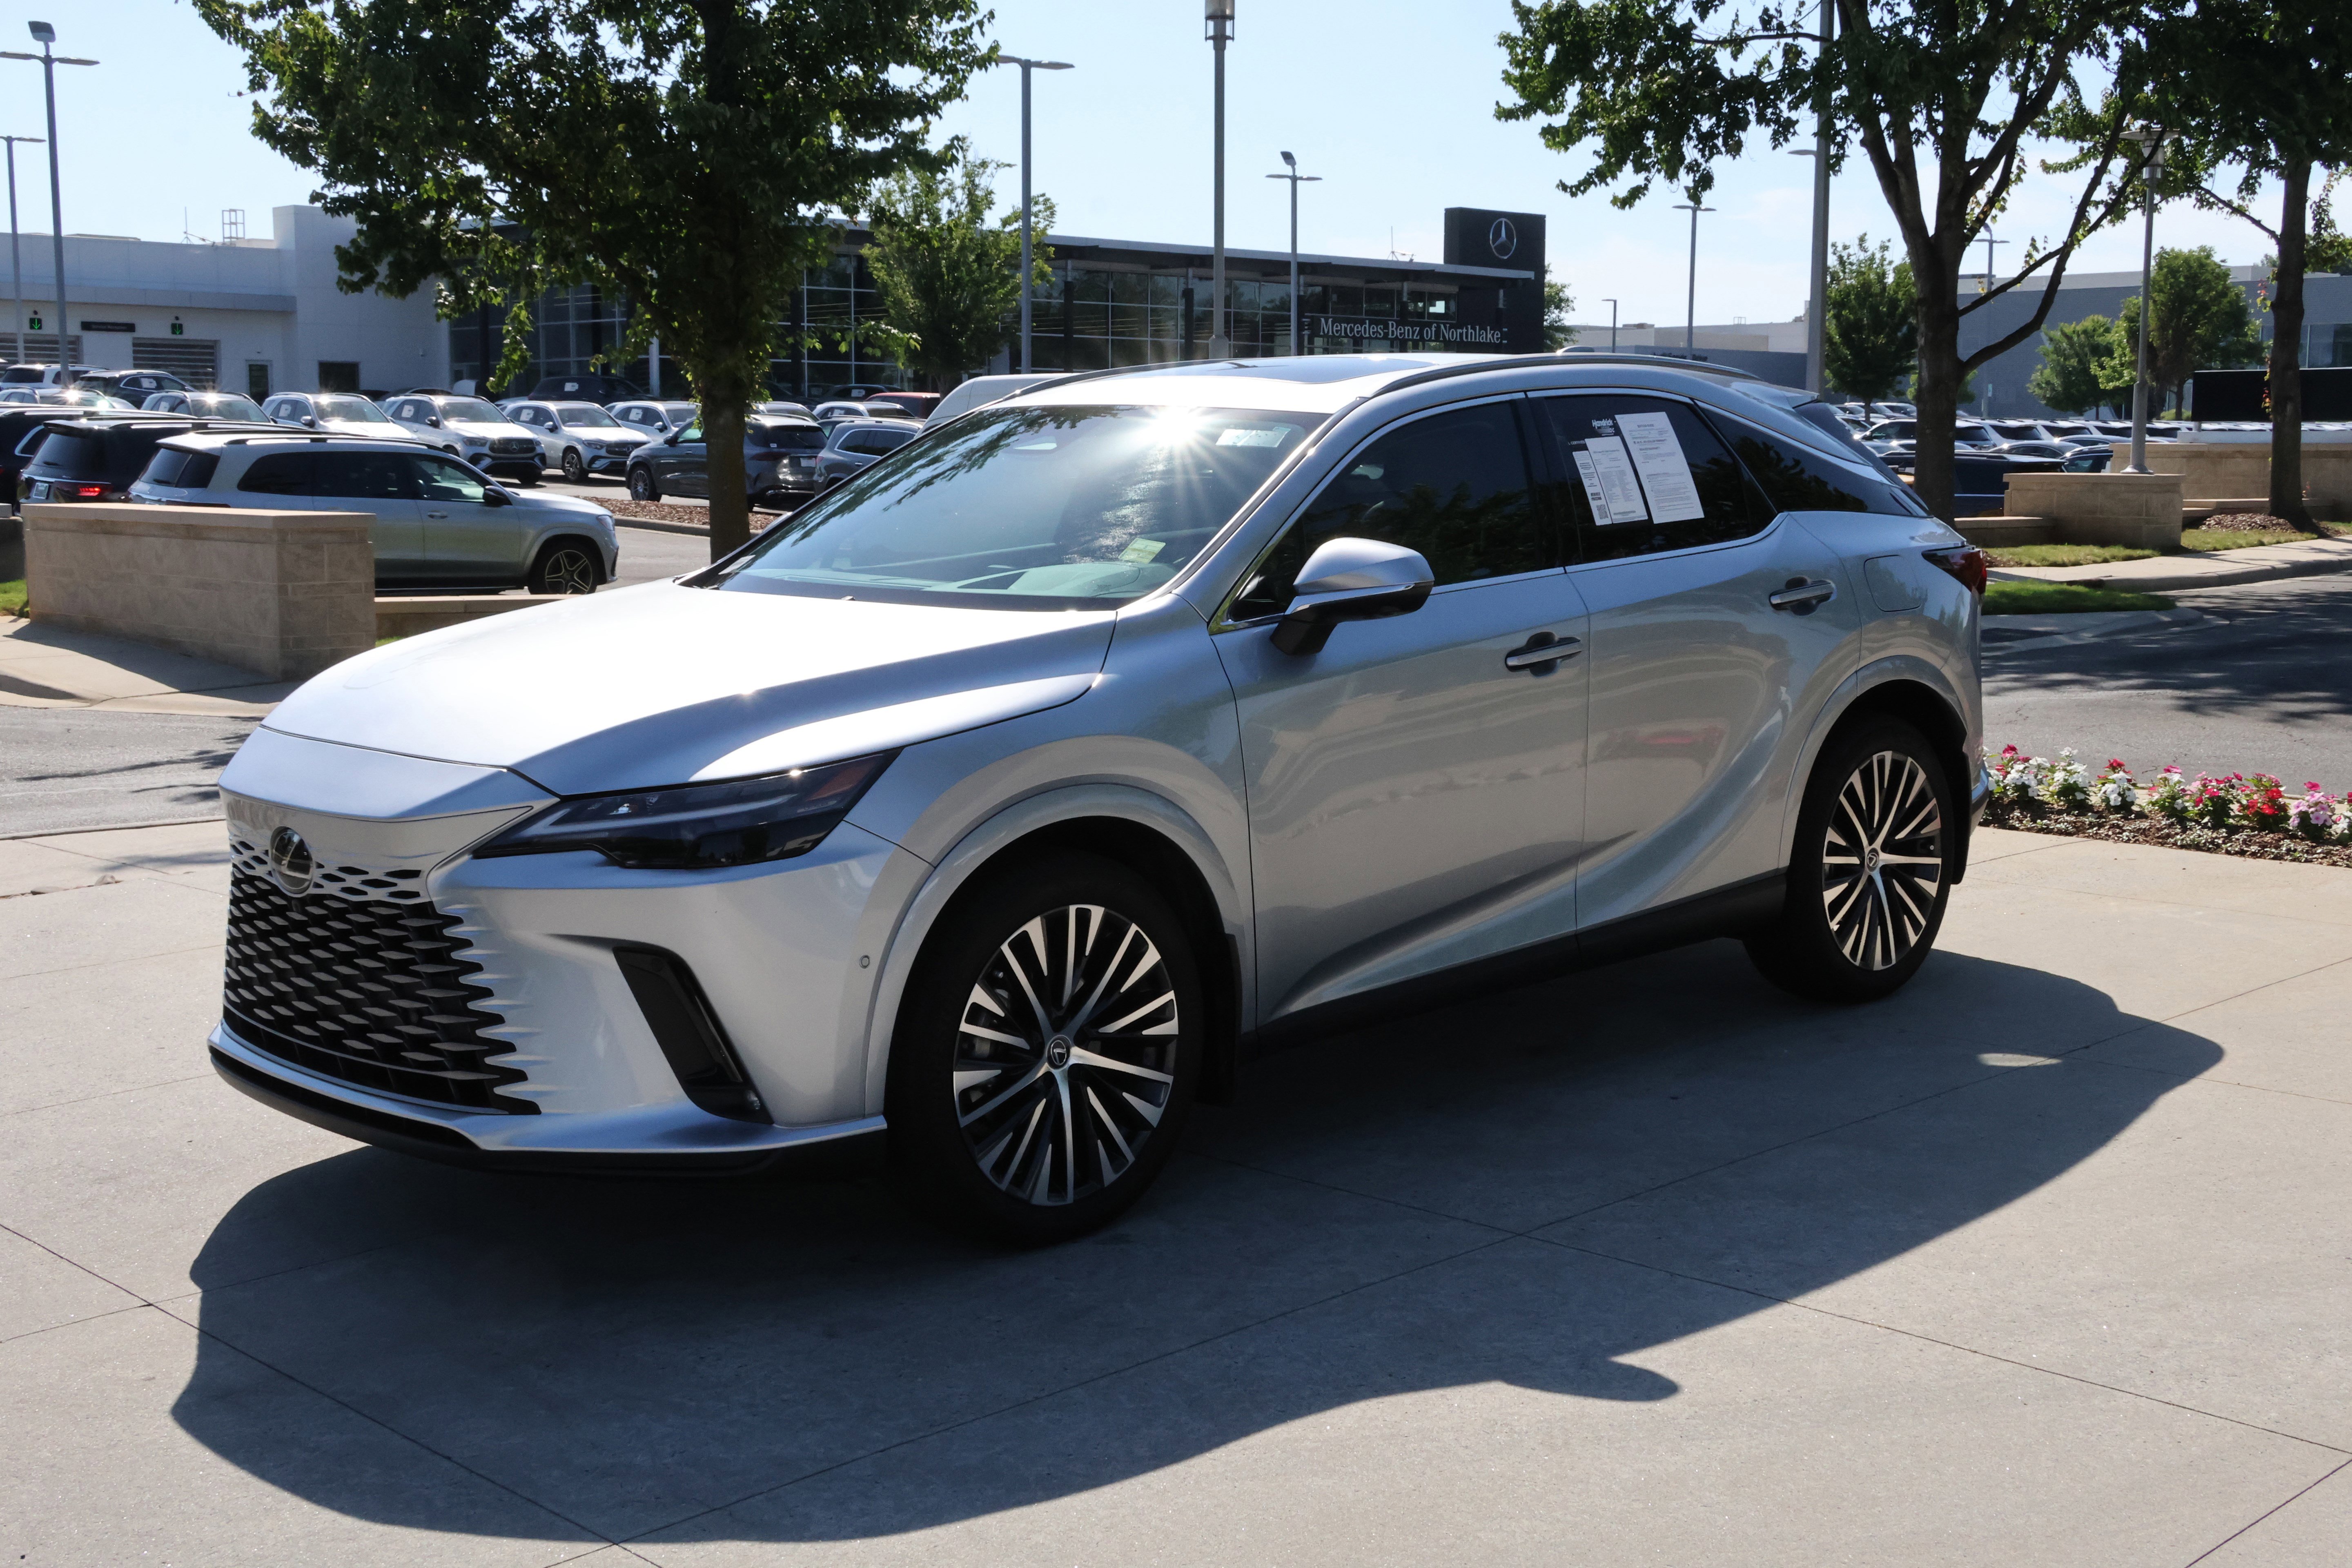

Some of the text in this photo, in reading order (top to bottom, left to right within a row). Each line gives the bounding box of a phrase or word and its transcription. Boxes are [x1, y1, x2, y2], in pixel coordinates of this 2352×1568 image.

[1320, 318, 1501, 343] Mercedes-Benz of Northlake
